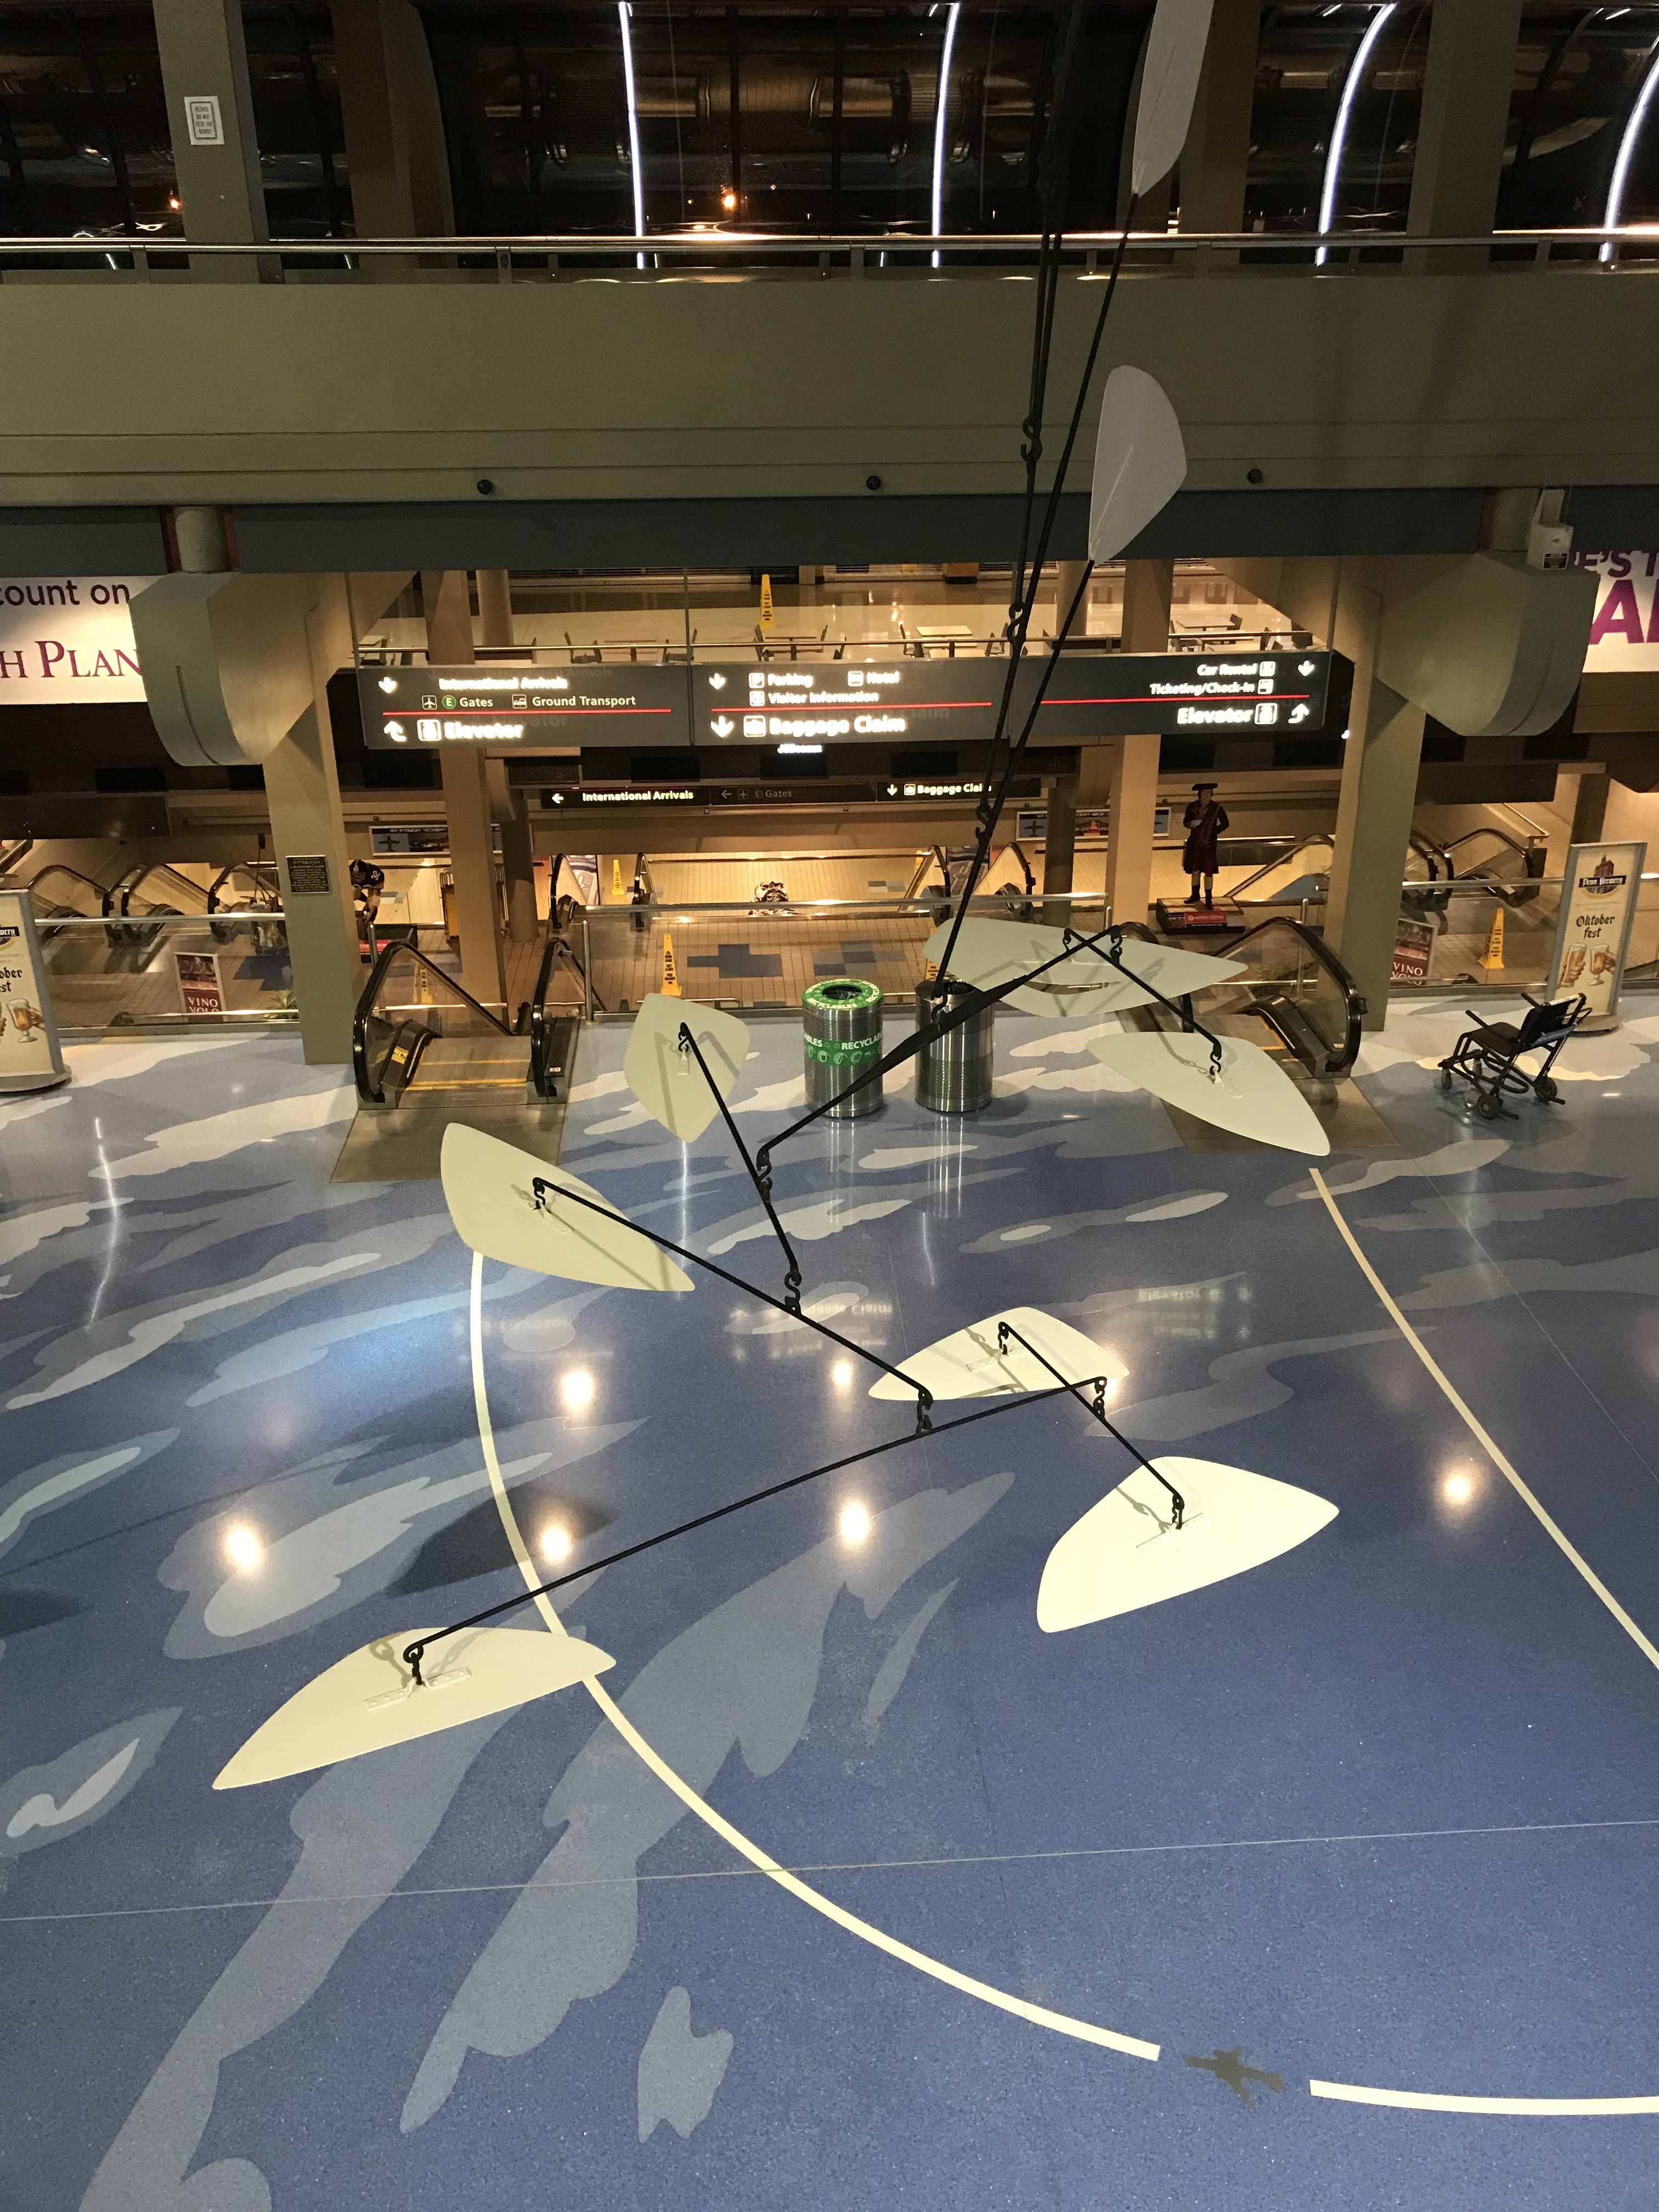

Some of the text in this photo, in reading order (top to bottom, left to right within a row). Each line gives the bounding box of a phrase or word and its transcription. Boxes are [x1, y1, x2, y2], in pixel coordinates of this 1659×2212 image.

[91, 584, 130, 605] on
[1197, 664, 1218, 676] Car
[439, 677, 568, 690] International Arrivals
[768, 673, 813, 687] Parking
[459, 697, 493, 707] Gates
[532, 696, 576, 707] Ground
[579, 695, 636, 707] Transport
[768, 691, 879, 704] Visitor Information
[1177, 707, 1253, 724] Elevator
[444, 721, 523, 739] Elevator
[769, 715, 906, 737] Baggage Claim
[582, 790, 693, 802] International Arrivals
[765, 789, 792, 798] Gates
[917, 785, 961, 795] Baggage
[371, 870, 381, 881] 32
[1576, 913, 1615, 927] Oktober
[1583, 927, 1602, 940] fest
[1393, 962, 1423, 977] VINO
[188, 997, 218, 1007] VINO
